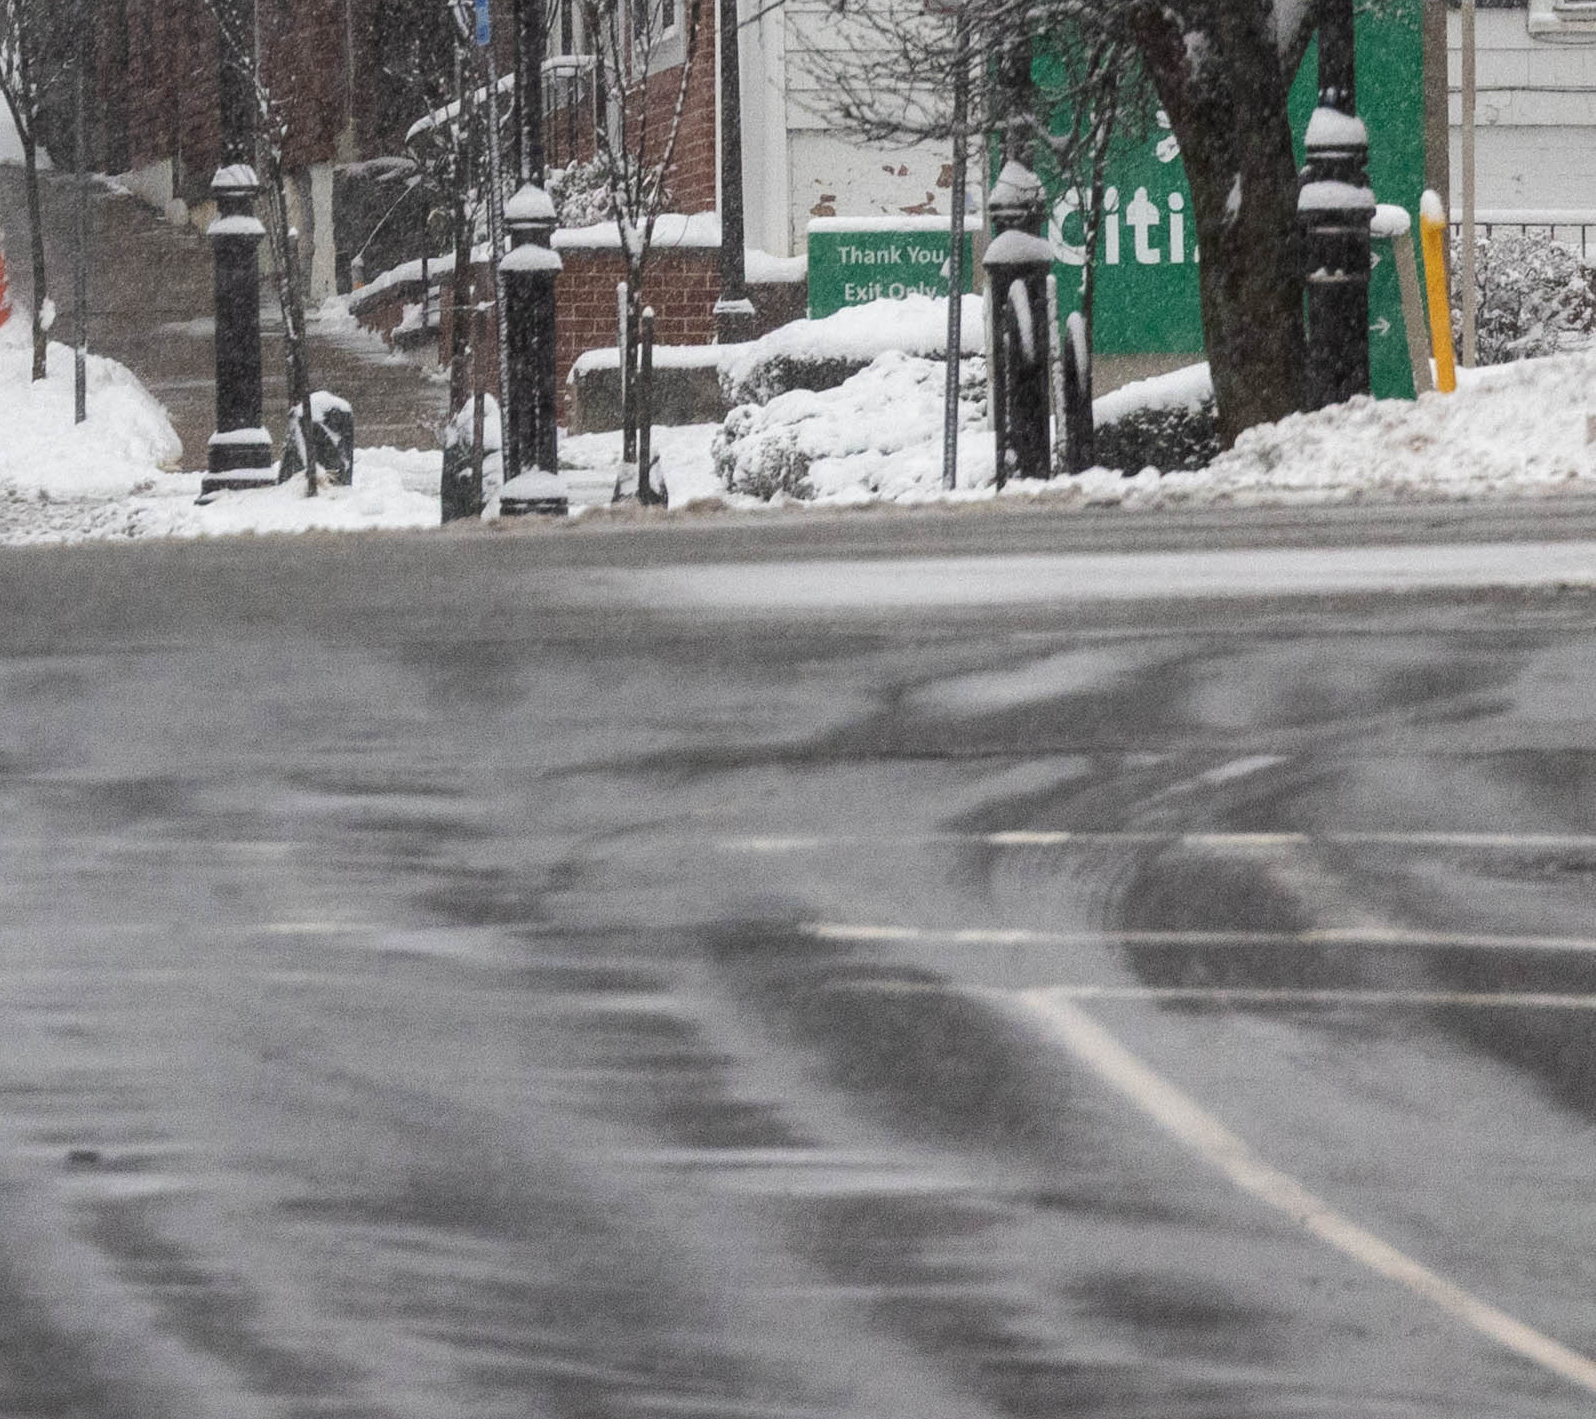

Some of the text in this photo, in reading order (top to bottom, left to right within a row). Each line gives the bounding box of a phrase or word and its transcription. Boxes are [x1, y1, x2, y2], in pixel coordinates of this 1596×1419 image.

[1047, 185, 1201, 266] Citi
[837, 245, 945, 264] Thank You
[844, 281, 938, 301] Exit Only
